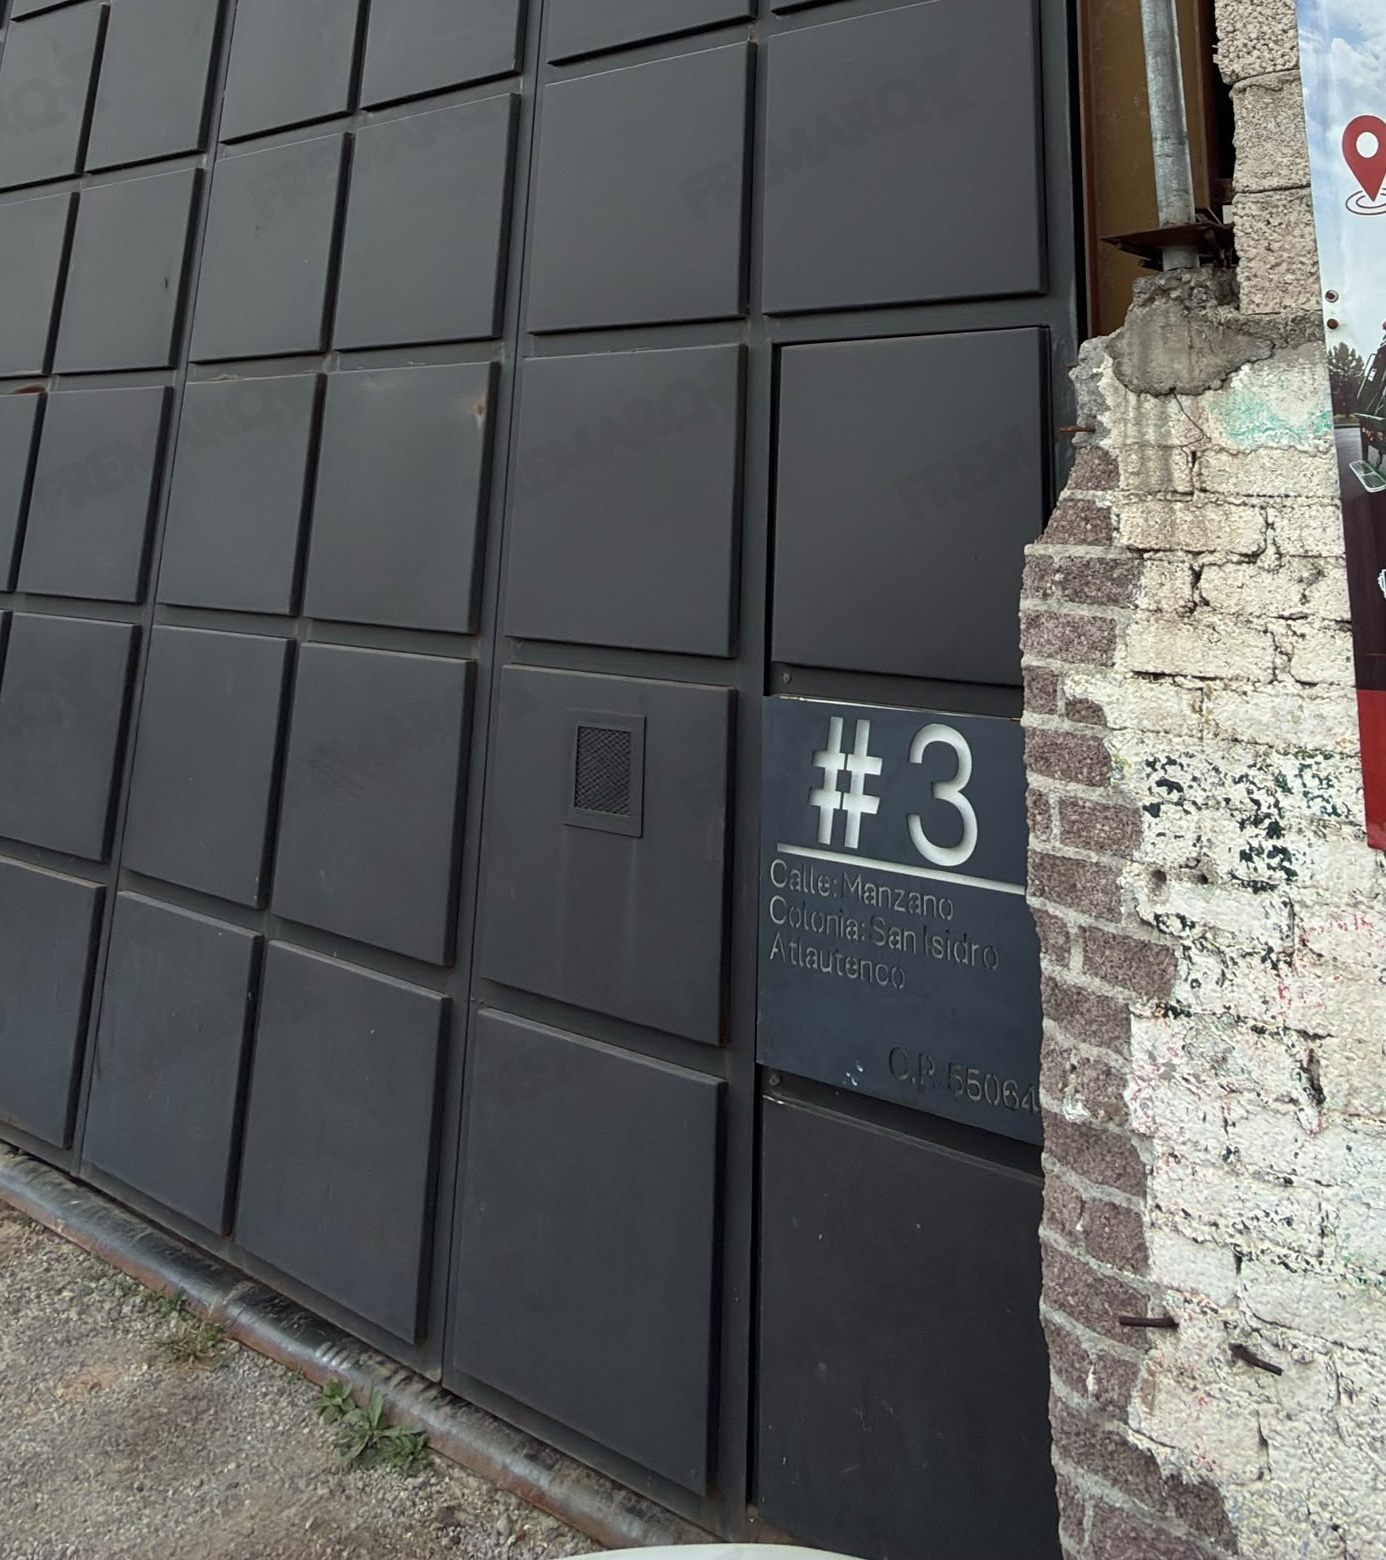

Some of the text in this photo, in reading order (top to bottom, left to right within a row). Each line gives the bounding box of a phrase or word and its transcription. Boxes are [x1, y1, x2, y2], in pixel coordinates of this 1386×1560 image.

[770, 858, 954, 920] Calle: Manzano
[769, 895, 999, 970] Colonia: San Isidro
[769, 932, 906, 989] Atlautenco
